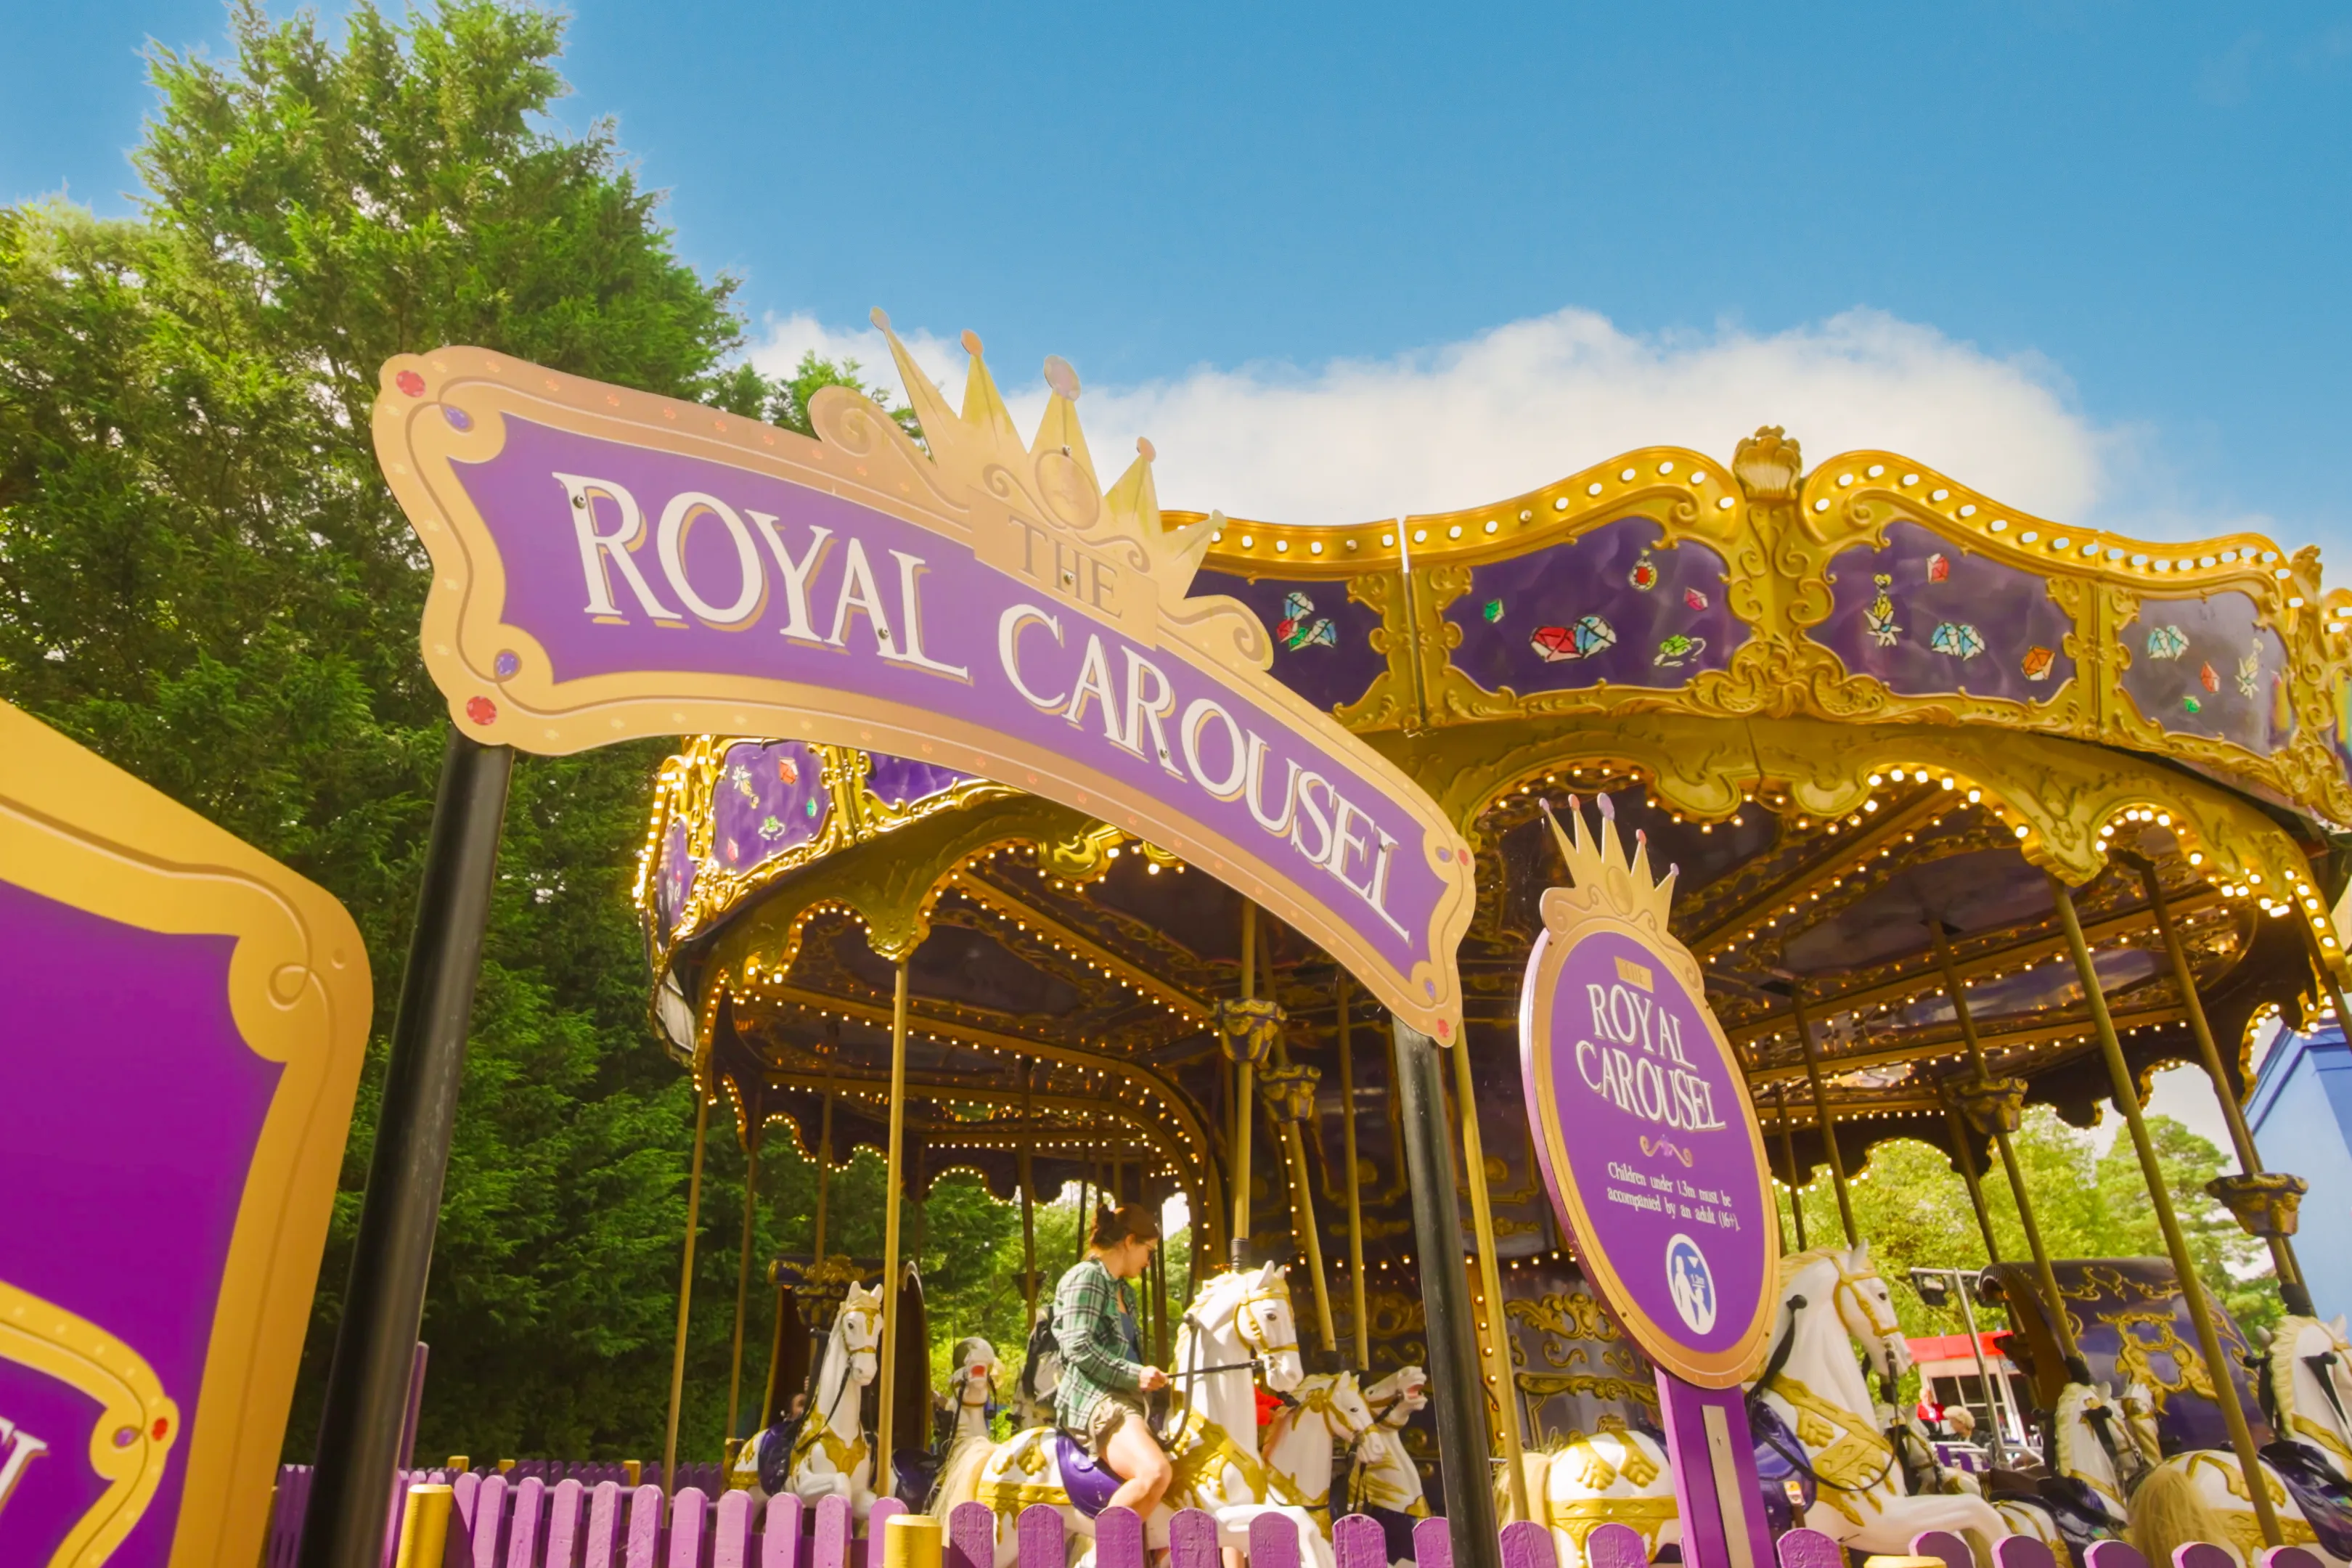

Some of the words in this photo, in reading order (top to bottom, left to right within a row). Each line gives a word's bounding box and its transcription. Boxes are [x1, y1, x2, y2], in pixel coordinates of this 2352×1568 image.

[1008, 515, 1123, 619] THE
[552, 472, 968, 680] ROYAL
[998, 603, 1410, 941] CAROUSEL
[1622, 961, 1645, 984] THE
[1585, 984, 1697, 1072] ROYAL
[1575, 1040, 1726, 1132] CAROUSEL
[1606, 1186, 1662, 1212] accompanied
[1664, 1196, 1676, 1220] by
[1680, 1204, 1692, 1219] an
[1695, 1205, 1716, 1225] adult
[1607, 1161, 1646, 1186] Children
[1650, 1173, 1673, 1193] under
[1699, 1188, 1719, 1204] must
[1720, 1190, 1732, 1207] be
